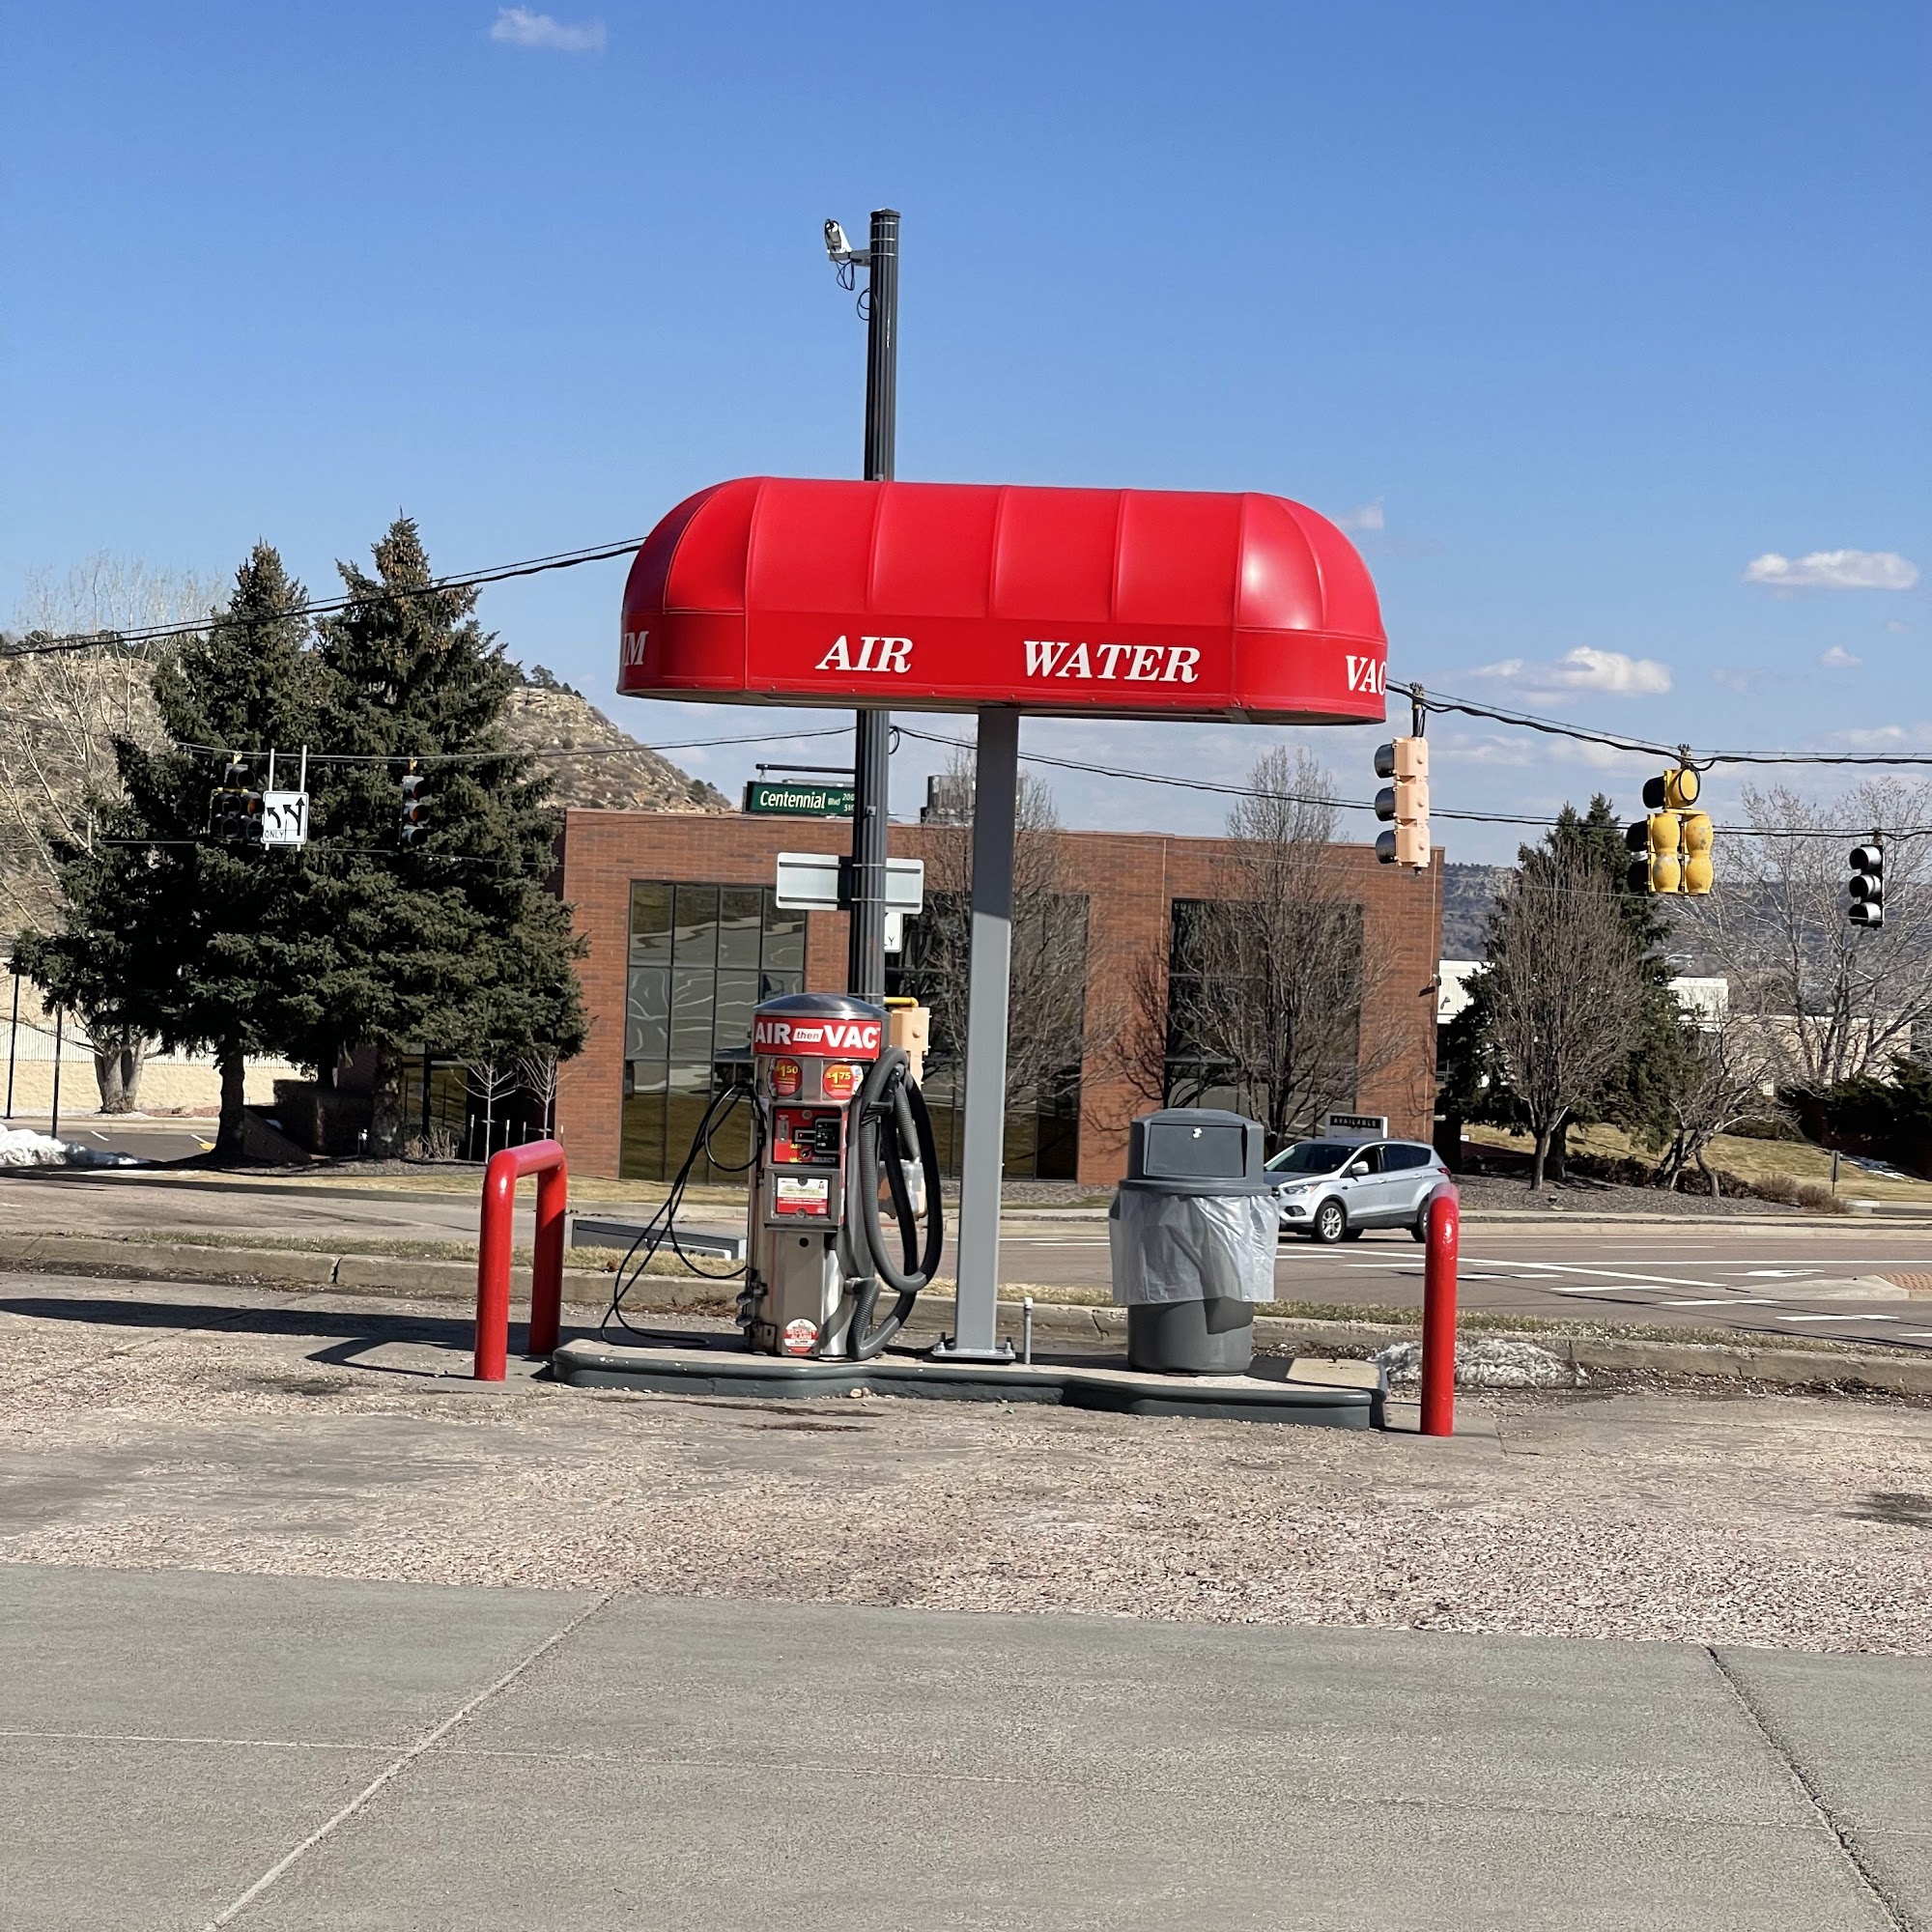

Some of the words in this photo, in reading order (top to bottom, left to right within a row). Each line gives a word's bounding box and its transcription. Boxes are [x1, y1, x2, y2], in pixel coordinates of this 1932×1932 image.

[815, 635, 914, 673] AIR
[1024, 640, 1201, 684] WATER
[1345, 655, 1387, 696] VAC
[759, 790, 826, 809] Centennial
[264, 830, 284, 838] ONLY
[754, 1022, 792, 1045] AIR
[796, 1031, 820, 1040] then
[823, 1025, 878, 1049] VAC
[1333, 1118, 1377, 1126] AVAILABLE
